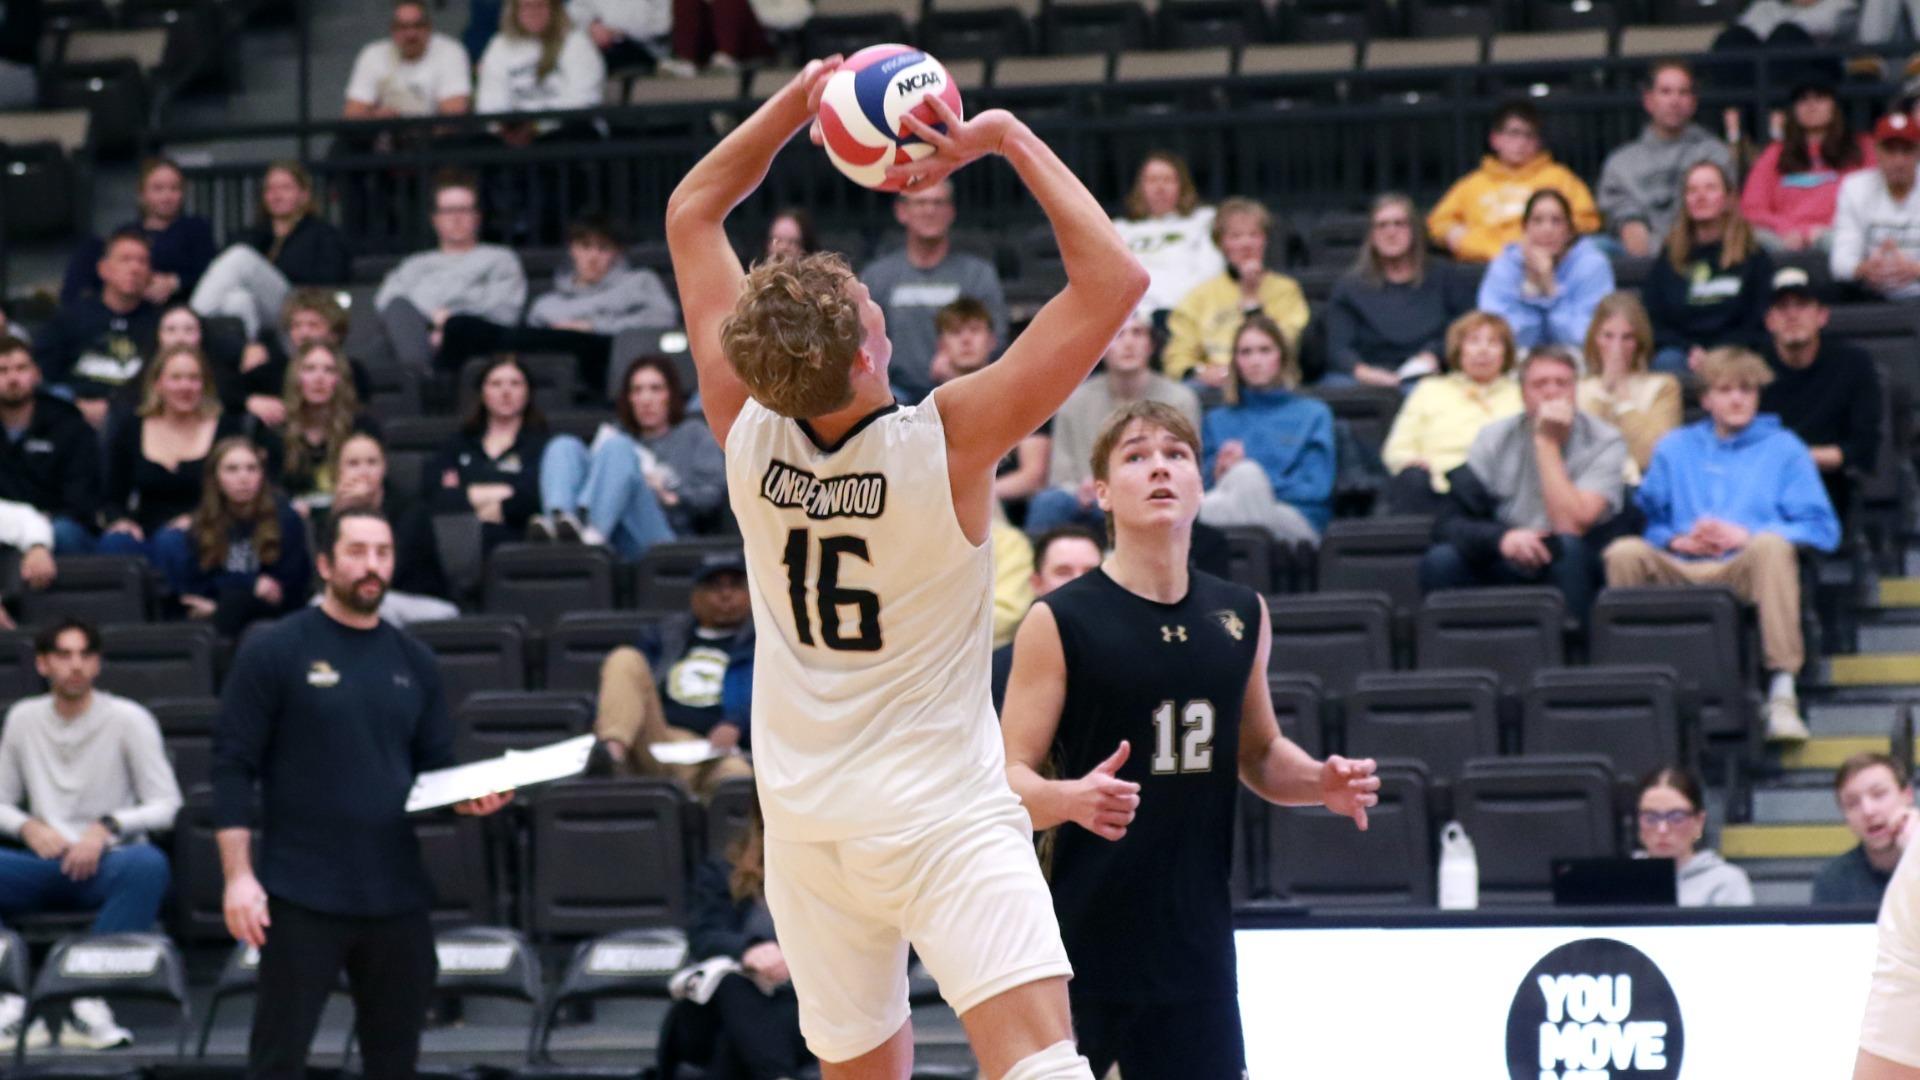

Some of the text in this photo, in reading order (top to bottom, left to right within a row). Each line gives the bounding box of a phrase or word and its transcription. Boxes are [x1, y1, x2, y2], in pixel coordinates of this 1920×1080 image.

[897, 71, 941, 96] NCAA
[782, 527, 884, 652] 16
[1151, 699, 1216, 775] 12
[1537, 973, 1632, 1024] YOU
[1538, 1020, 1668, 1071] MOVE
